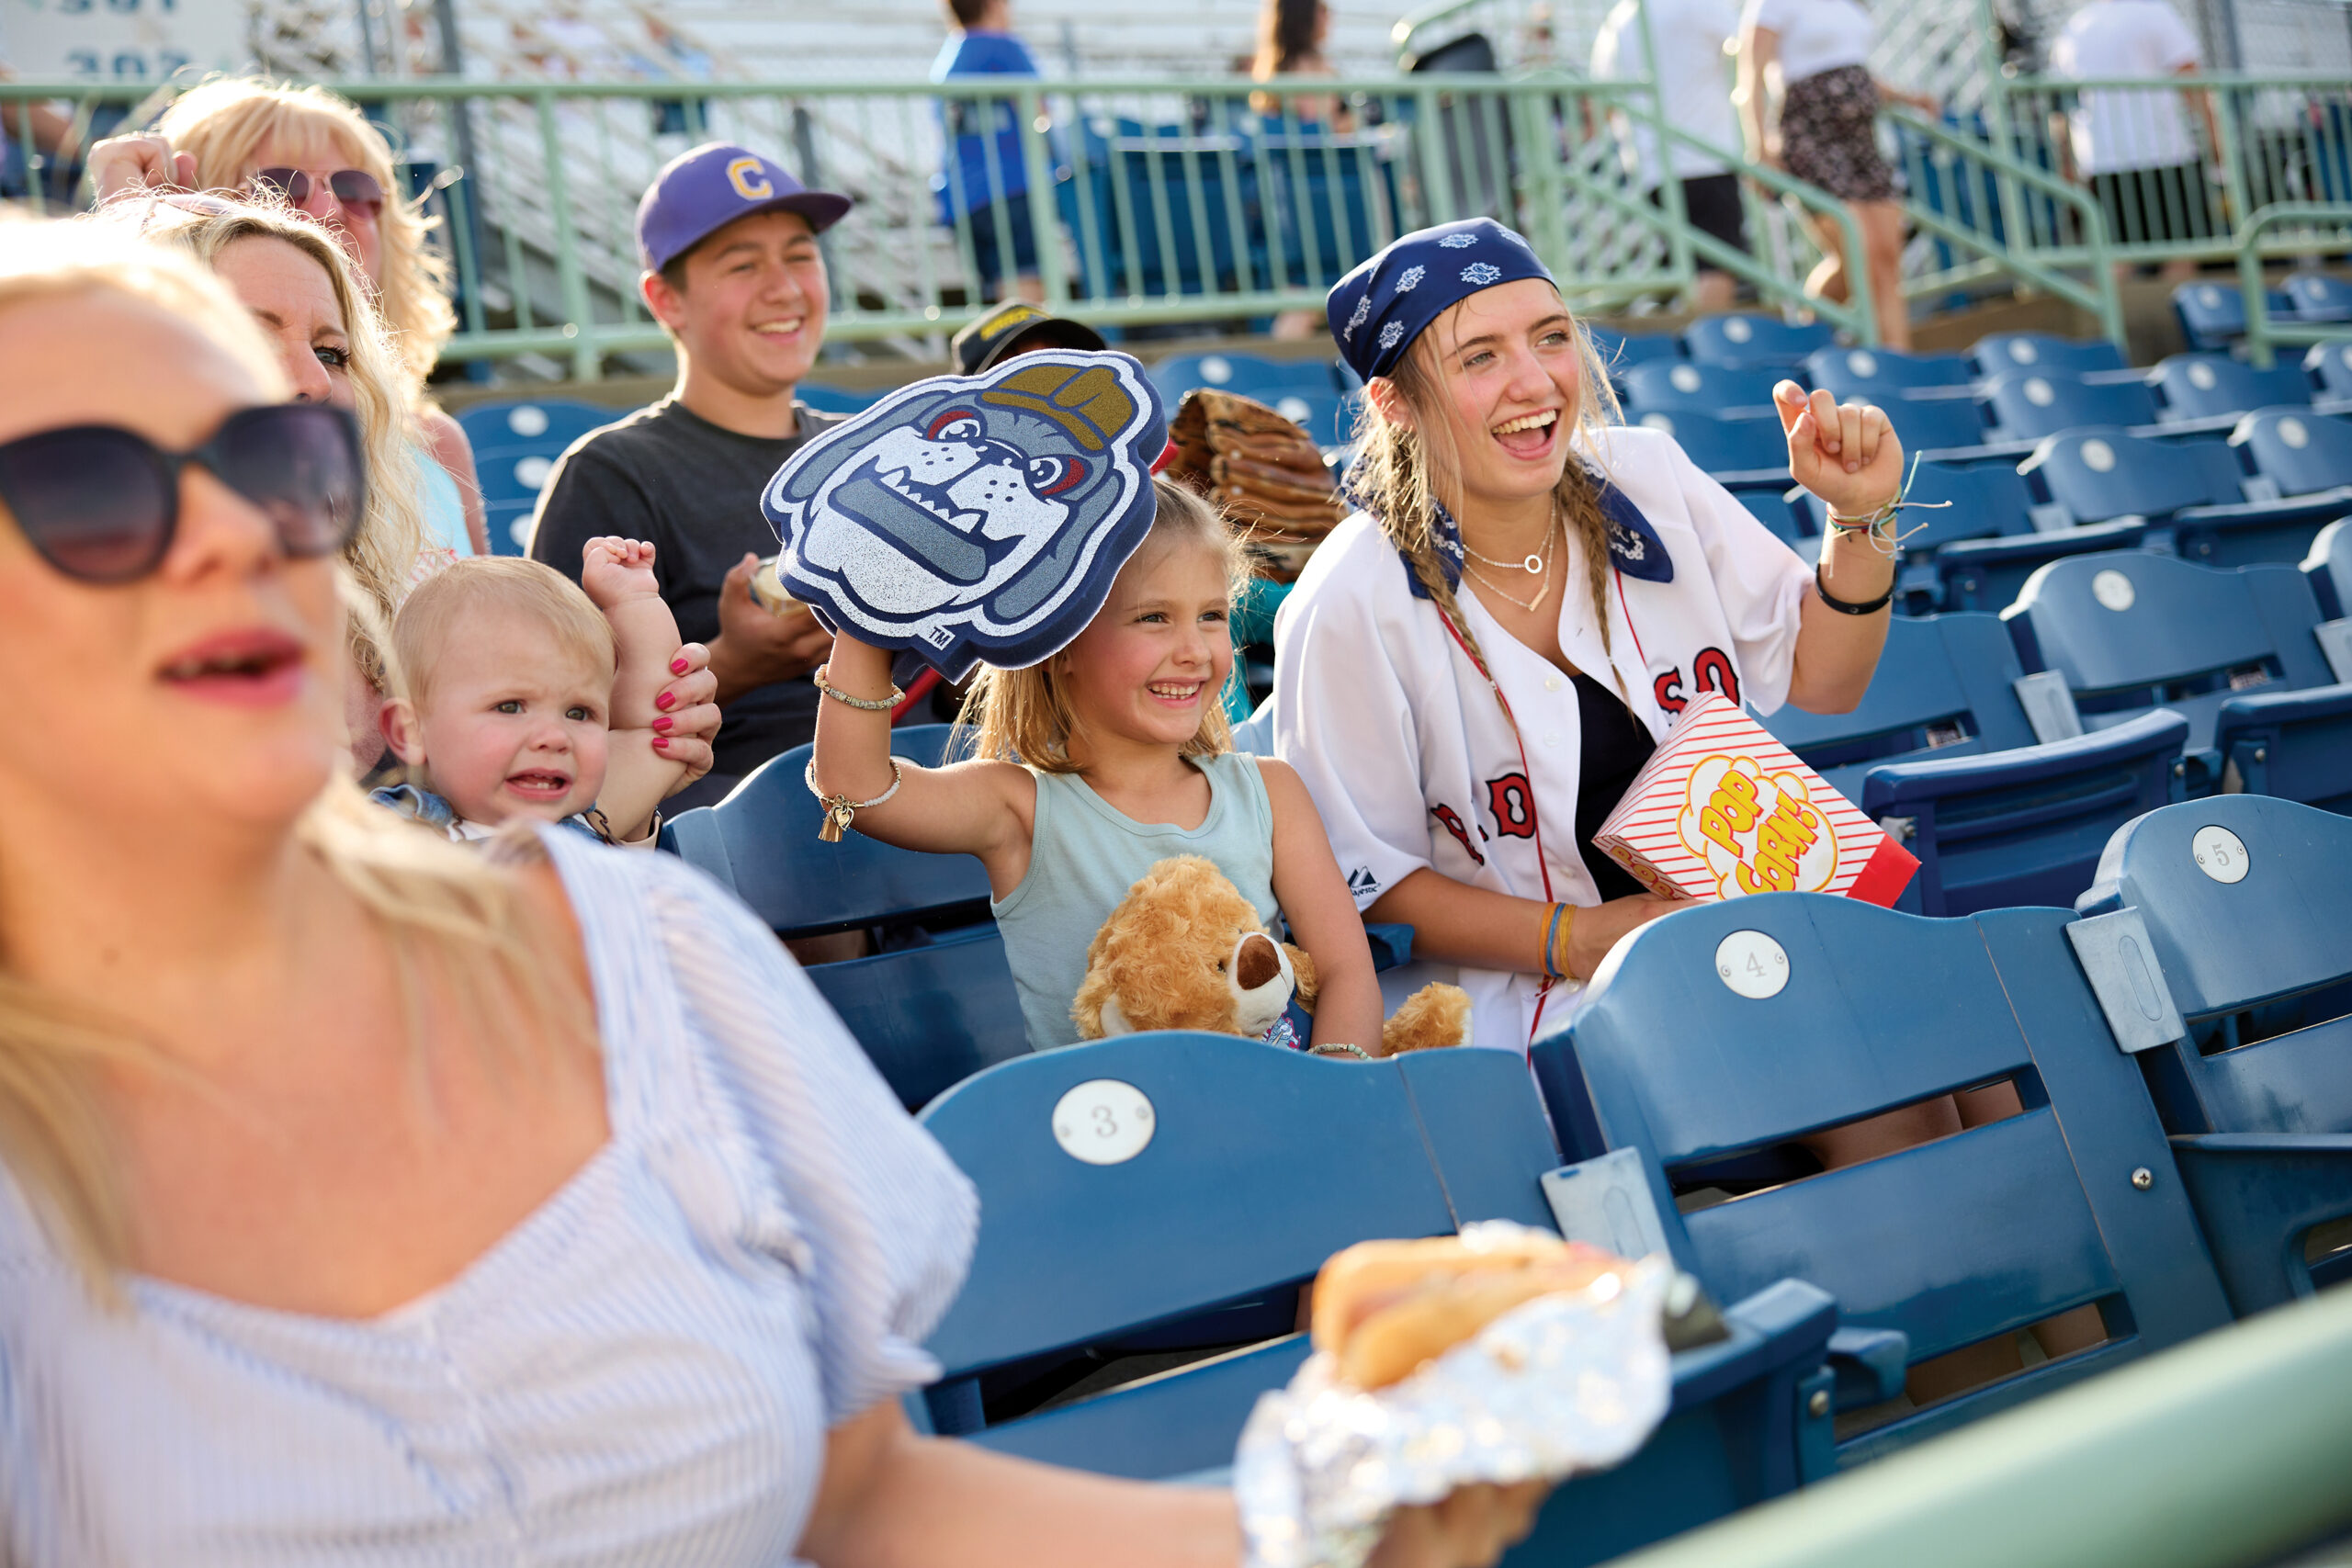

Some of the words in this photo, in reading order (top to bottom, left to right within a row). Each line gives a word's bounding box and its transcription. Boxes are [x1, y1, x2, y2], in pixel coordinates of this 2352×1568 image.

[726, 156, 774, 201] C
[928, 626, 951, 647] TM
[1430, 773, 1536, 866] RD
[1699, 769, 1765, 859] POP
[1735, 786, 1819, 895] CORN!
[2211, 842, 2231, 866] 5
[1746, 951, 1768, 977] 4
[1091, 1105, 1118, 1138] 3
